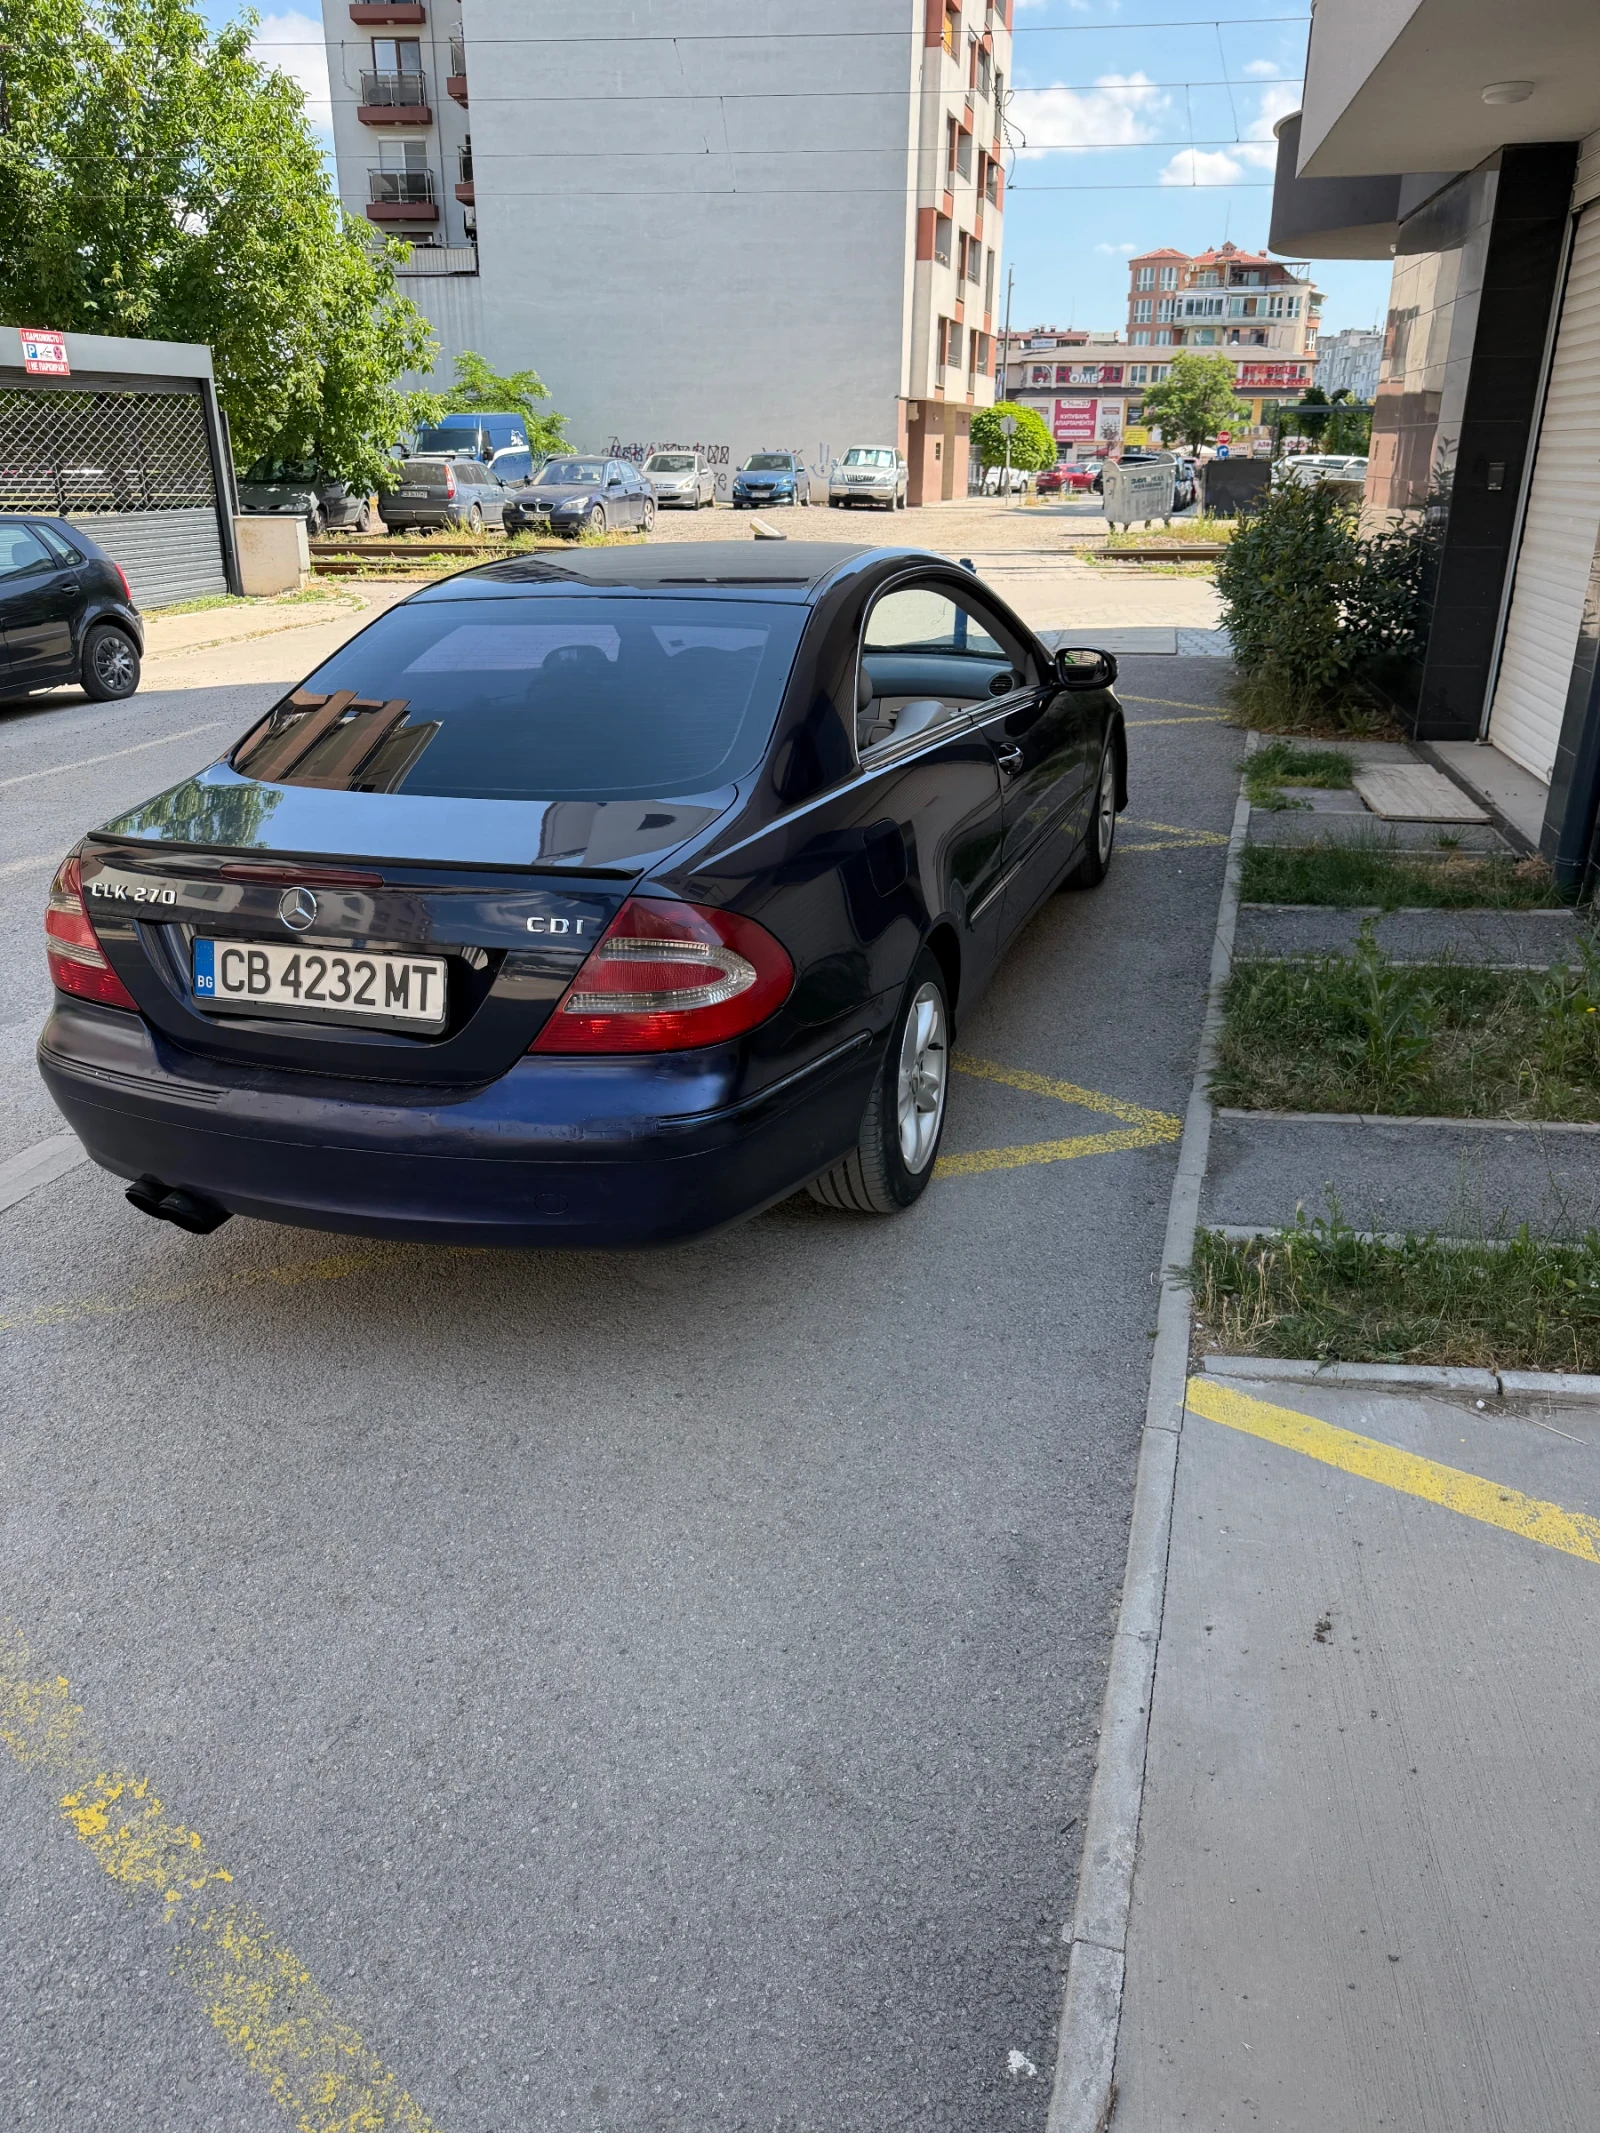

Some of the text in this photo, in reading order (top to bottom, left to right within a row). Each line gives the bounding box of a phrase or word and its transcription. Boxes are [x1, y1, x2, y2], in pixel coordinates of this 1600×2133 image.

[92, 882, 177, 905] CLK 270
[526, 916, 584, 935] CDI
[197, 975, 213, 988] BG
[220, 948, 438, 1012] CB 4232 MT
